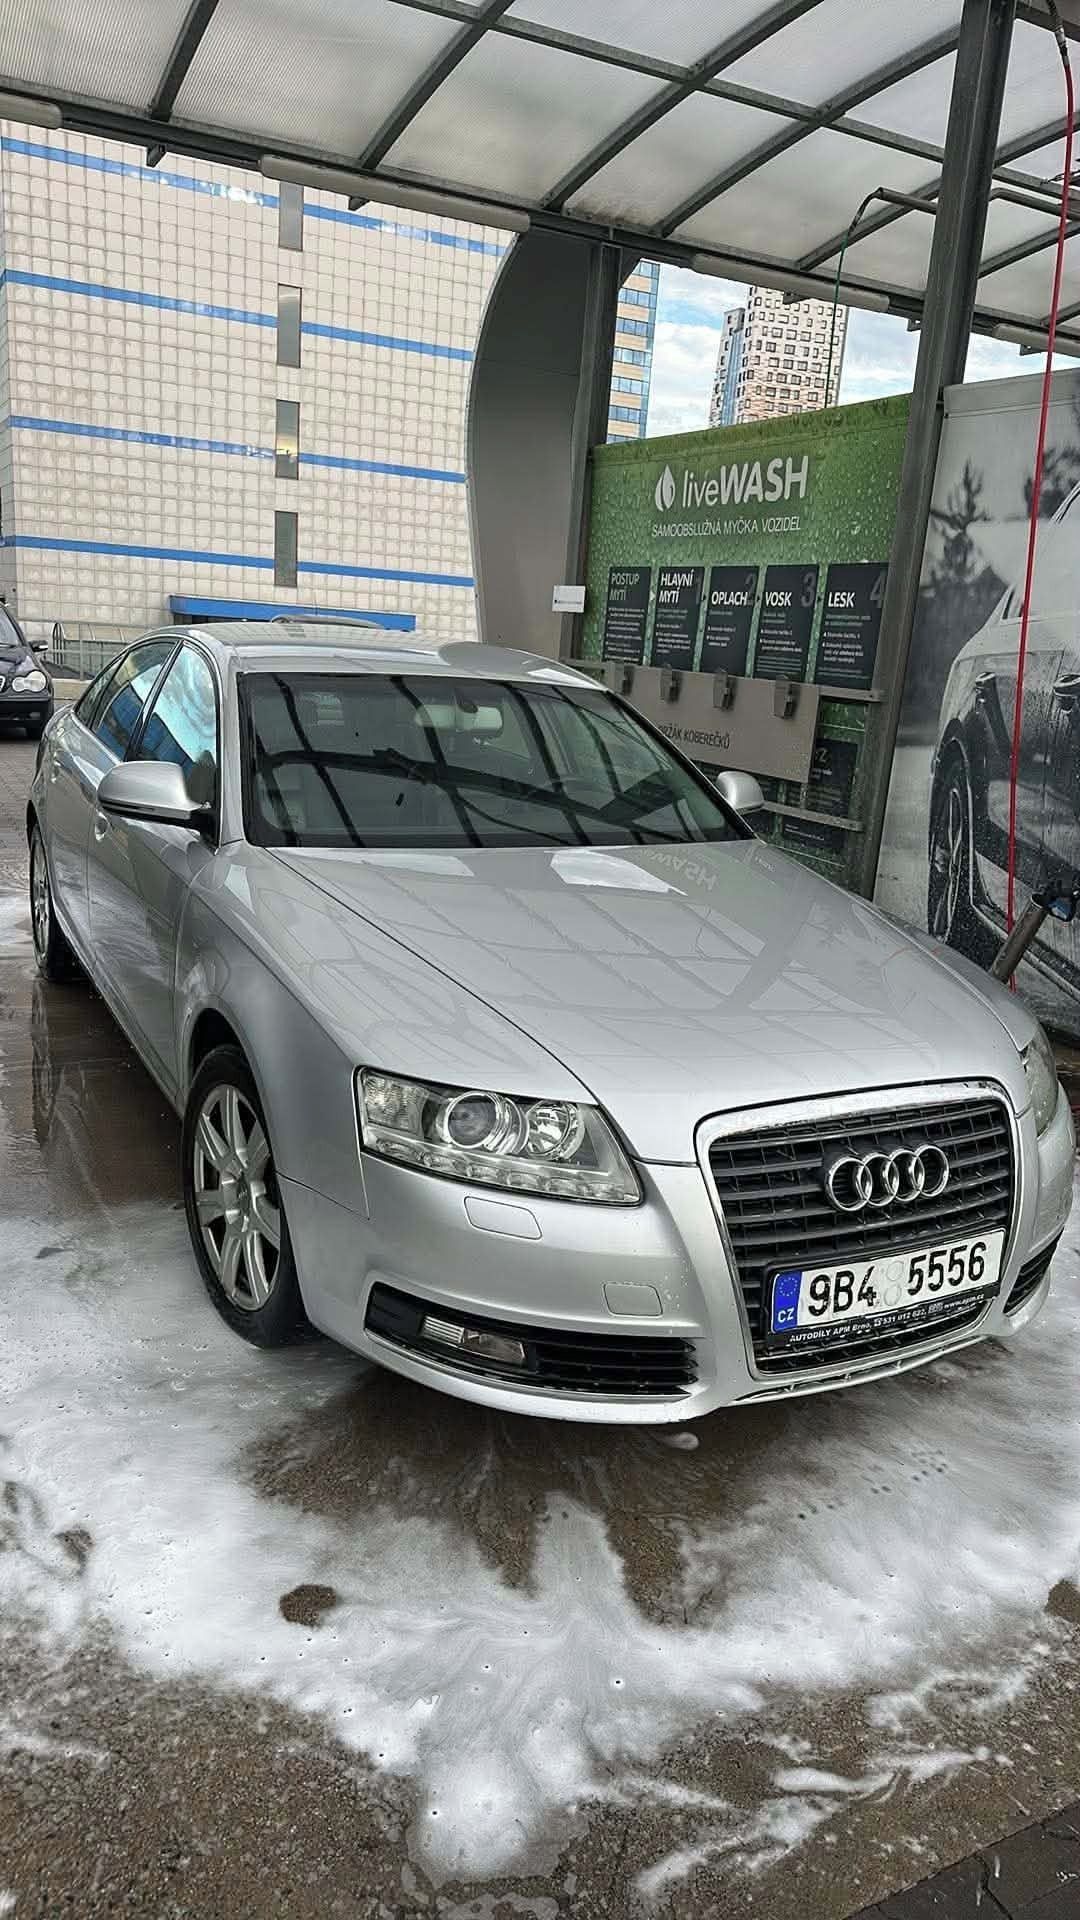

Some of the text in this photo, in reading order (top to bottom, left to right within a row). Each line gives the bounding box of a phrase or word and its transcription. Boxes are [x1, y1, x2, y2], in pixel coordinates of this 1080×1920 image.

[683, 455, 809, 508] liveWASH
[651, 514, 801, 537] SAMOOBSLUŽNÁ MYČKA VOZIDEL
[611, 572, 640, 585] POSTUP
[660, 568, 694, 587] HLAVNÍ
[658, 586, 680, 604] MYTÍ
[711, 591, 749, 606] OPLACH
[801, 572, 817, 607] 3
[765, 591, 793, 607] VOSK
[828, 591, 856, 608] LESK
[778, 1241, 987, 1323] CZ 9B4 5556
[789, 1329, 832, 1343] AUTODÍLY
